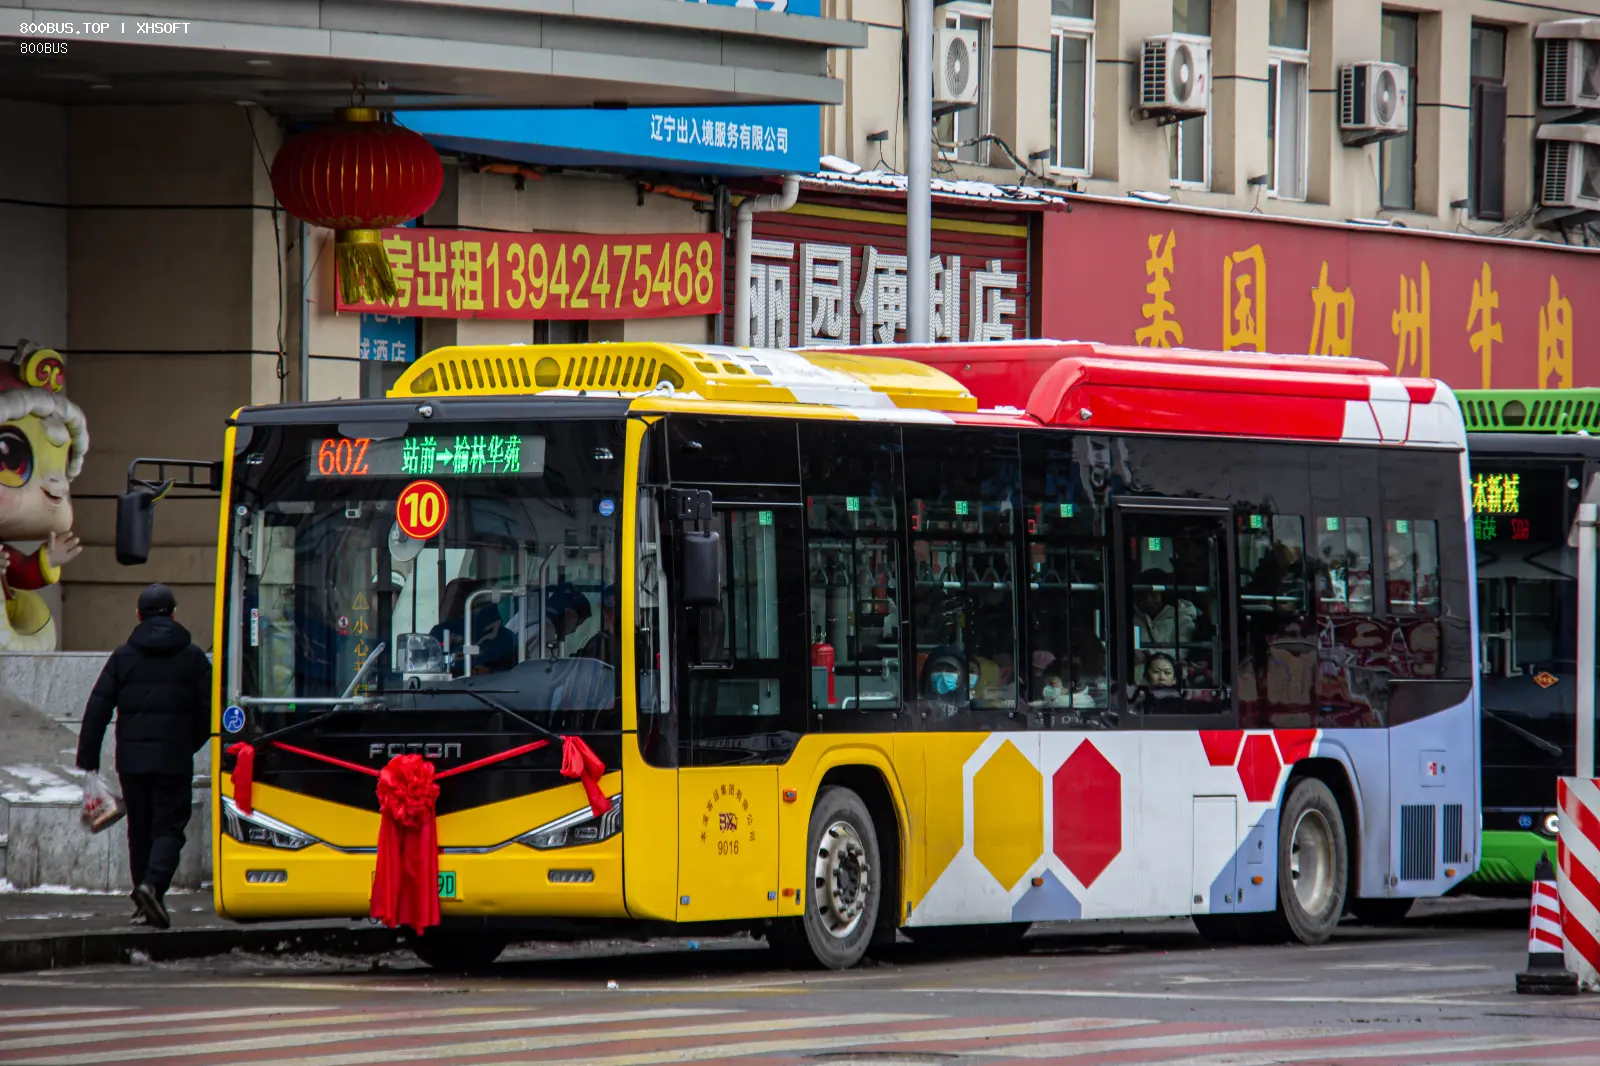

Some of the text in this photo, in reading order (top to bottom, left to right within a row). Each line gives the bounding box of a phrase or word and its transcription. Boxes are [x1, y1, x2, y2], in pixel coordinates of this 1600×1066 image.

[650, 114, 788, 154] 辽宁出入境服务有限公司
[360, 234, 714, 310] 房出租13942475468
[750, 239, 1018, 348] 丽园便利店
[1135, 228, 1573, 389] 美国加州牛肉
[401, 435, 521, 475] 站前 榆林华苑
[404, 492, 440, 528] 10
[717, 840, 739, 856] 9016
